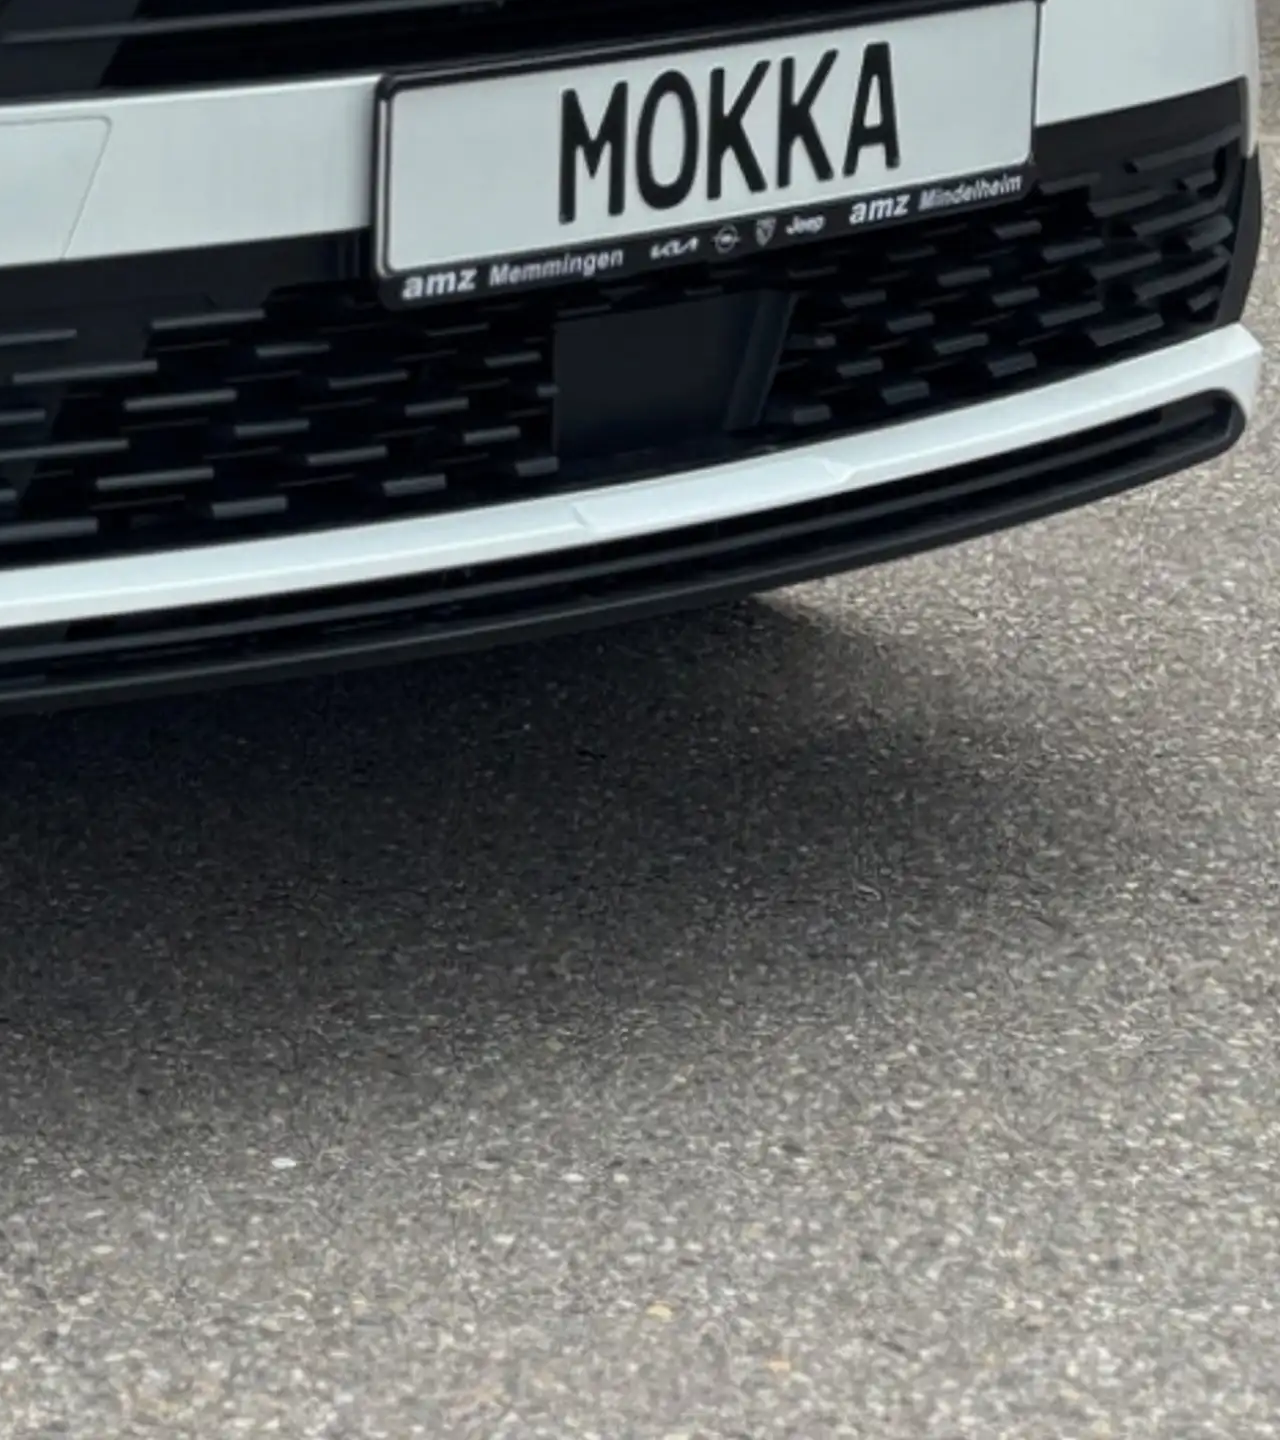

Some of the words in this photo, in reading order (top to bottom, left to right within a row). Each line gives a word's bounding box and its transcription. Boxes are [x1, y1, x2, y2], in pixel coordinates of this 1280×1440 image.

[559, 41, 901, 225] MOKKA
[401, 267, 479, 300] amz
[489, 248, 625, 287] Memmingen
[849, 194, 911, 226] amz
[918, 174, 1024, 211] Mindelheim
